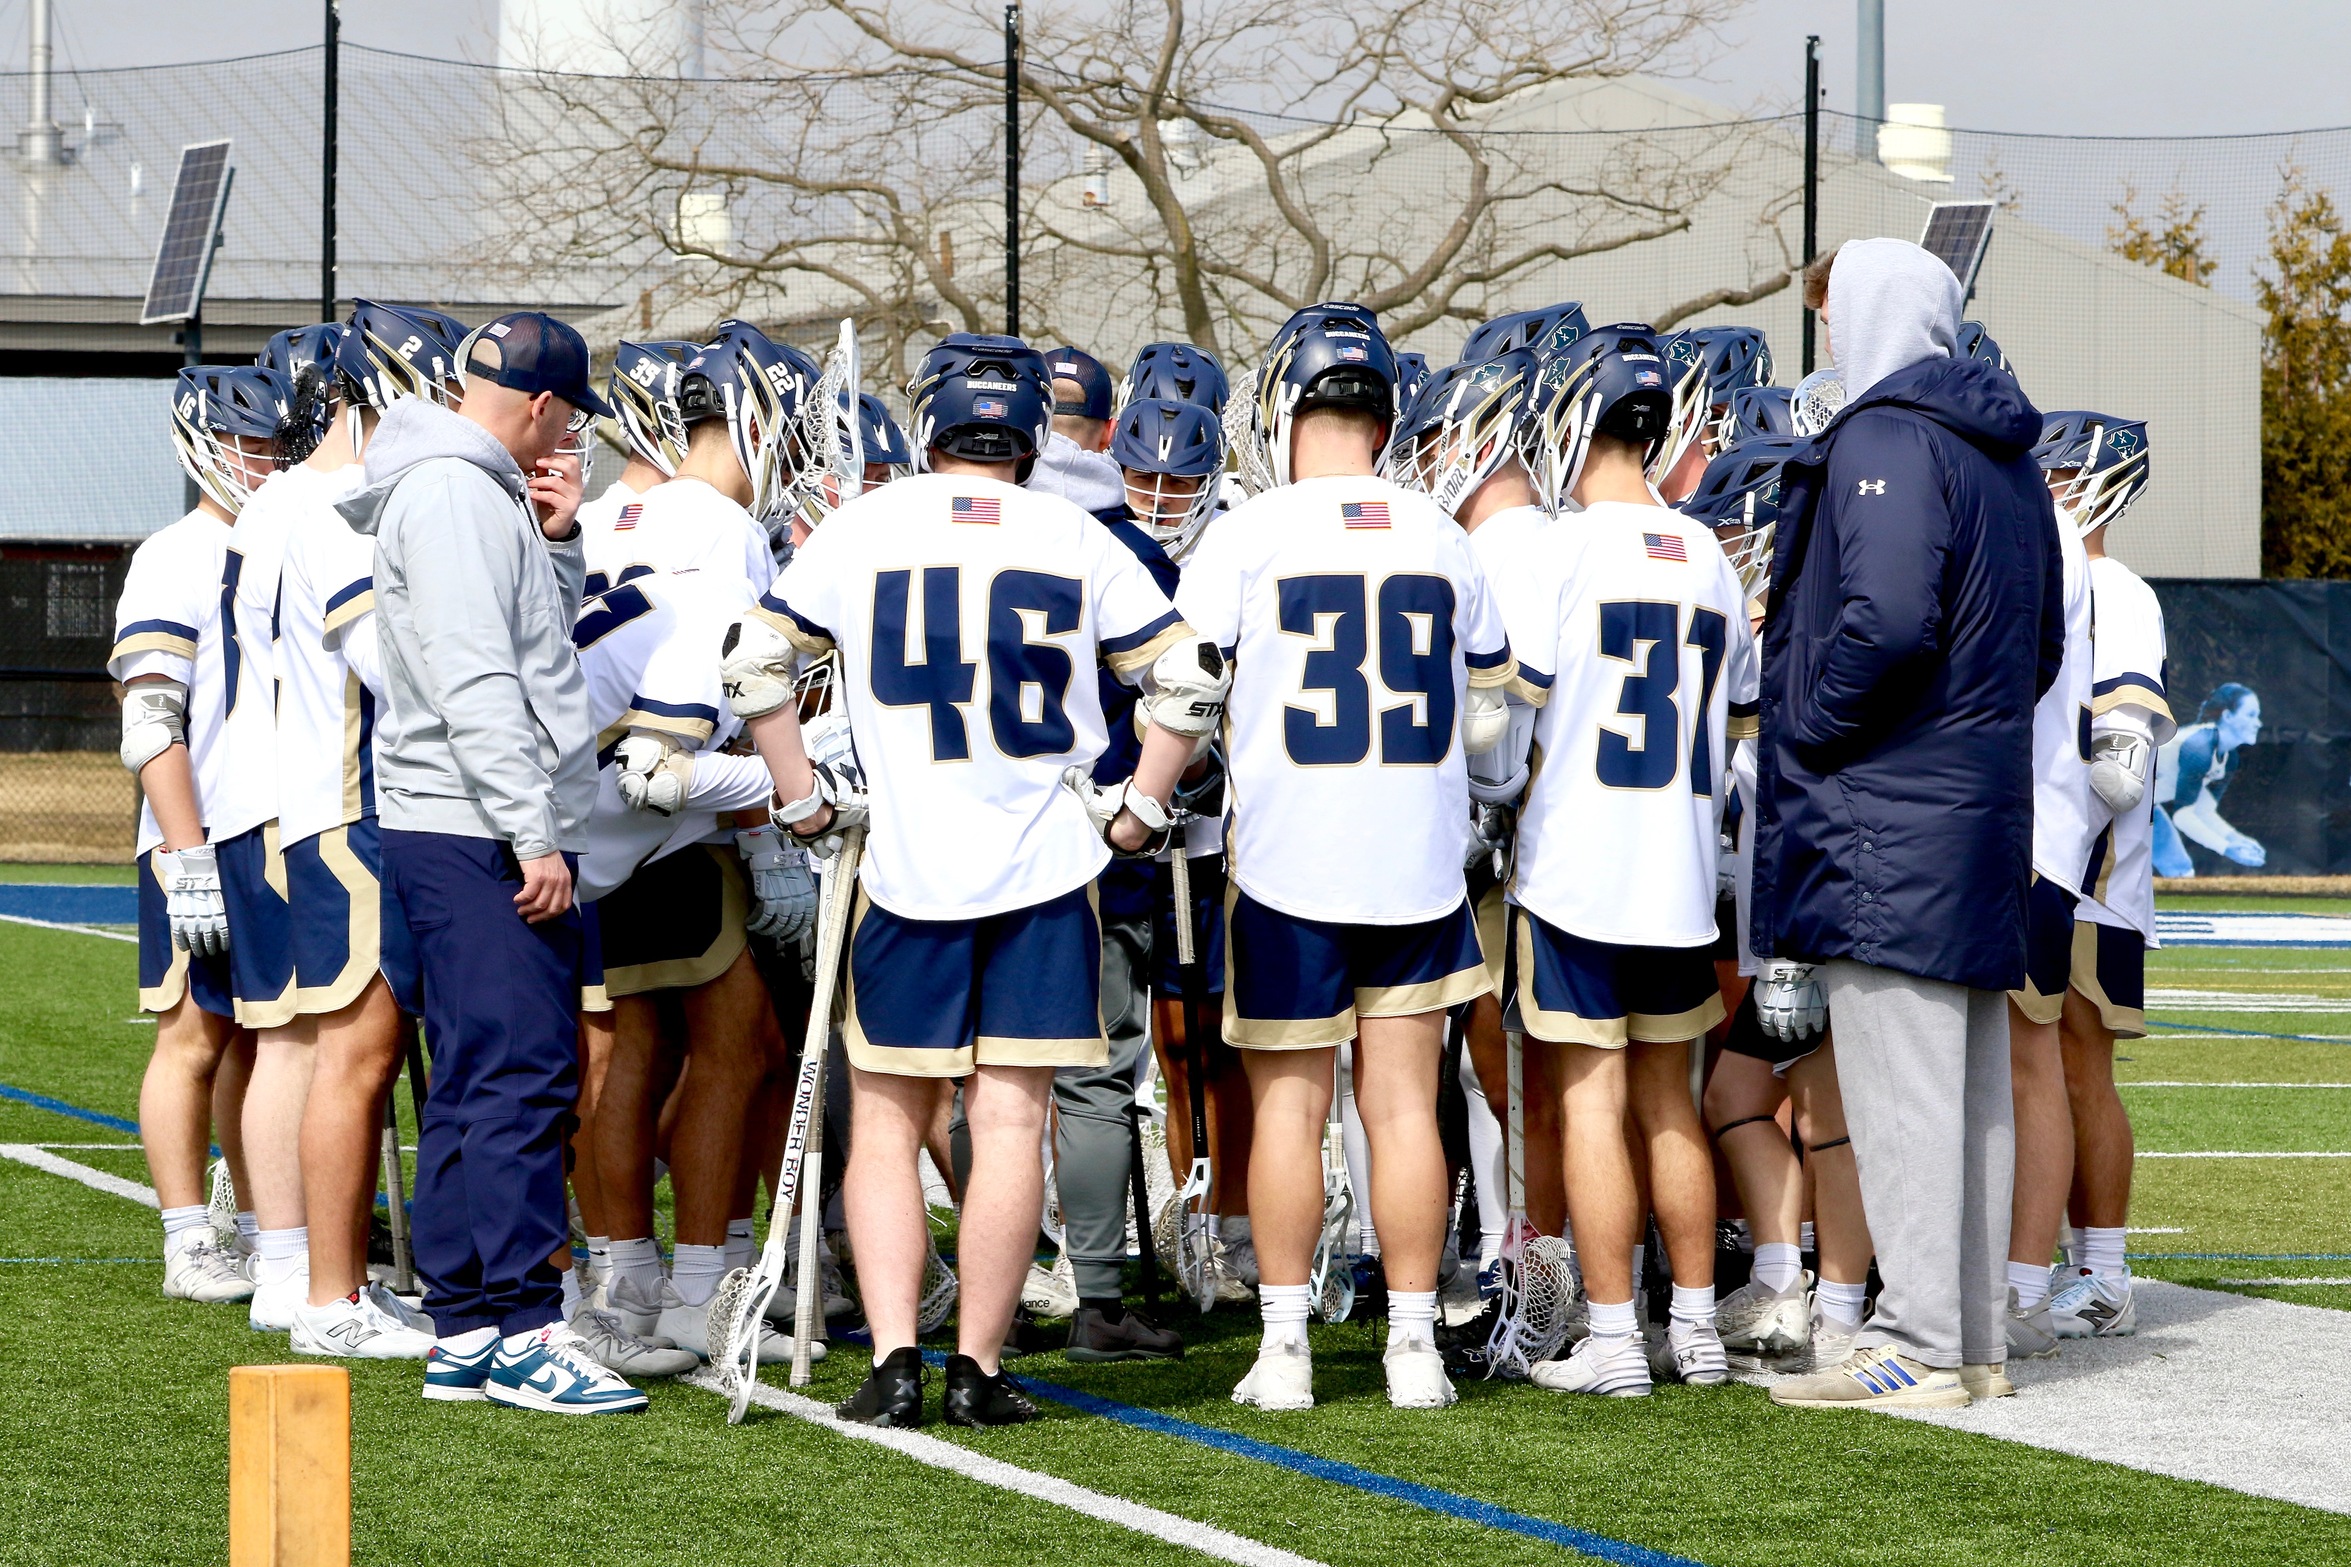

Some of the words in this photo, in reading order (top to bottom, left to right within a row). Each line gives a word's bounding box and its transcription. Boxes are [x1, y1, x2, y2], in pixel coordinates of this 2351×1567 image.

[397, 335, 423, 361] 2
[629, 357, 662, 388] 35
[764, 361, 796, 397] 22
[966, 381, 1018, 392] BUCCANEERS
[178, 391, 198, 420] 16
[1437, 467, 1469, 508] 3/17/22
[867, 563, 1086, 765] 46
[1274, 571, 1458, 768] 39
[1465, 852, 1477, 867] STX
[1772, 966, 1816, 982] STX
[789, 1060, 818, 1150] WONDER
[781, 1157, 799, 1202] BOY
[1021, 1299, 1050, 1309] lance
